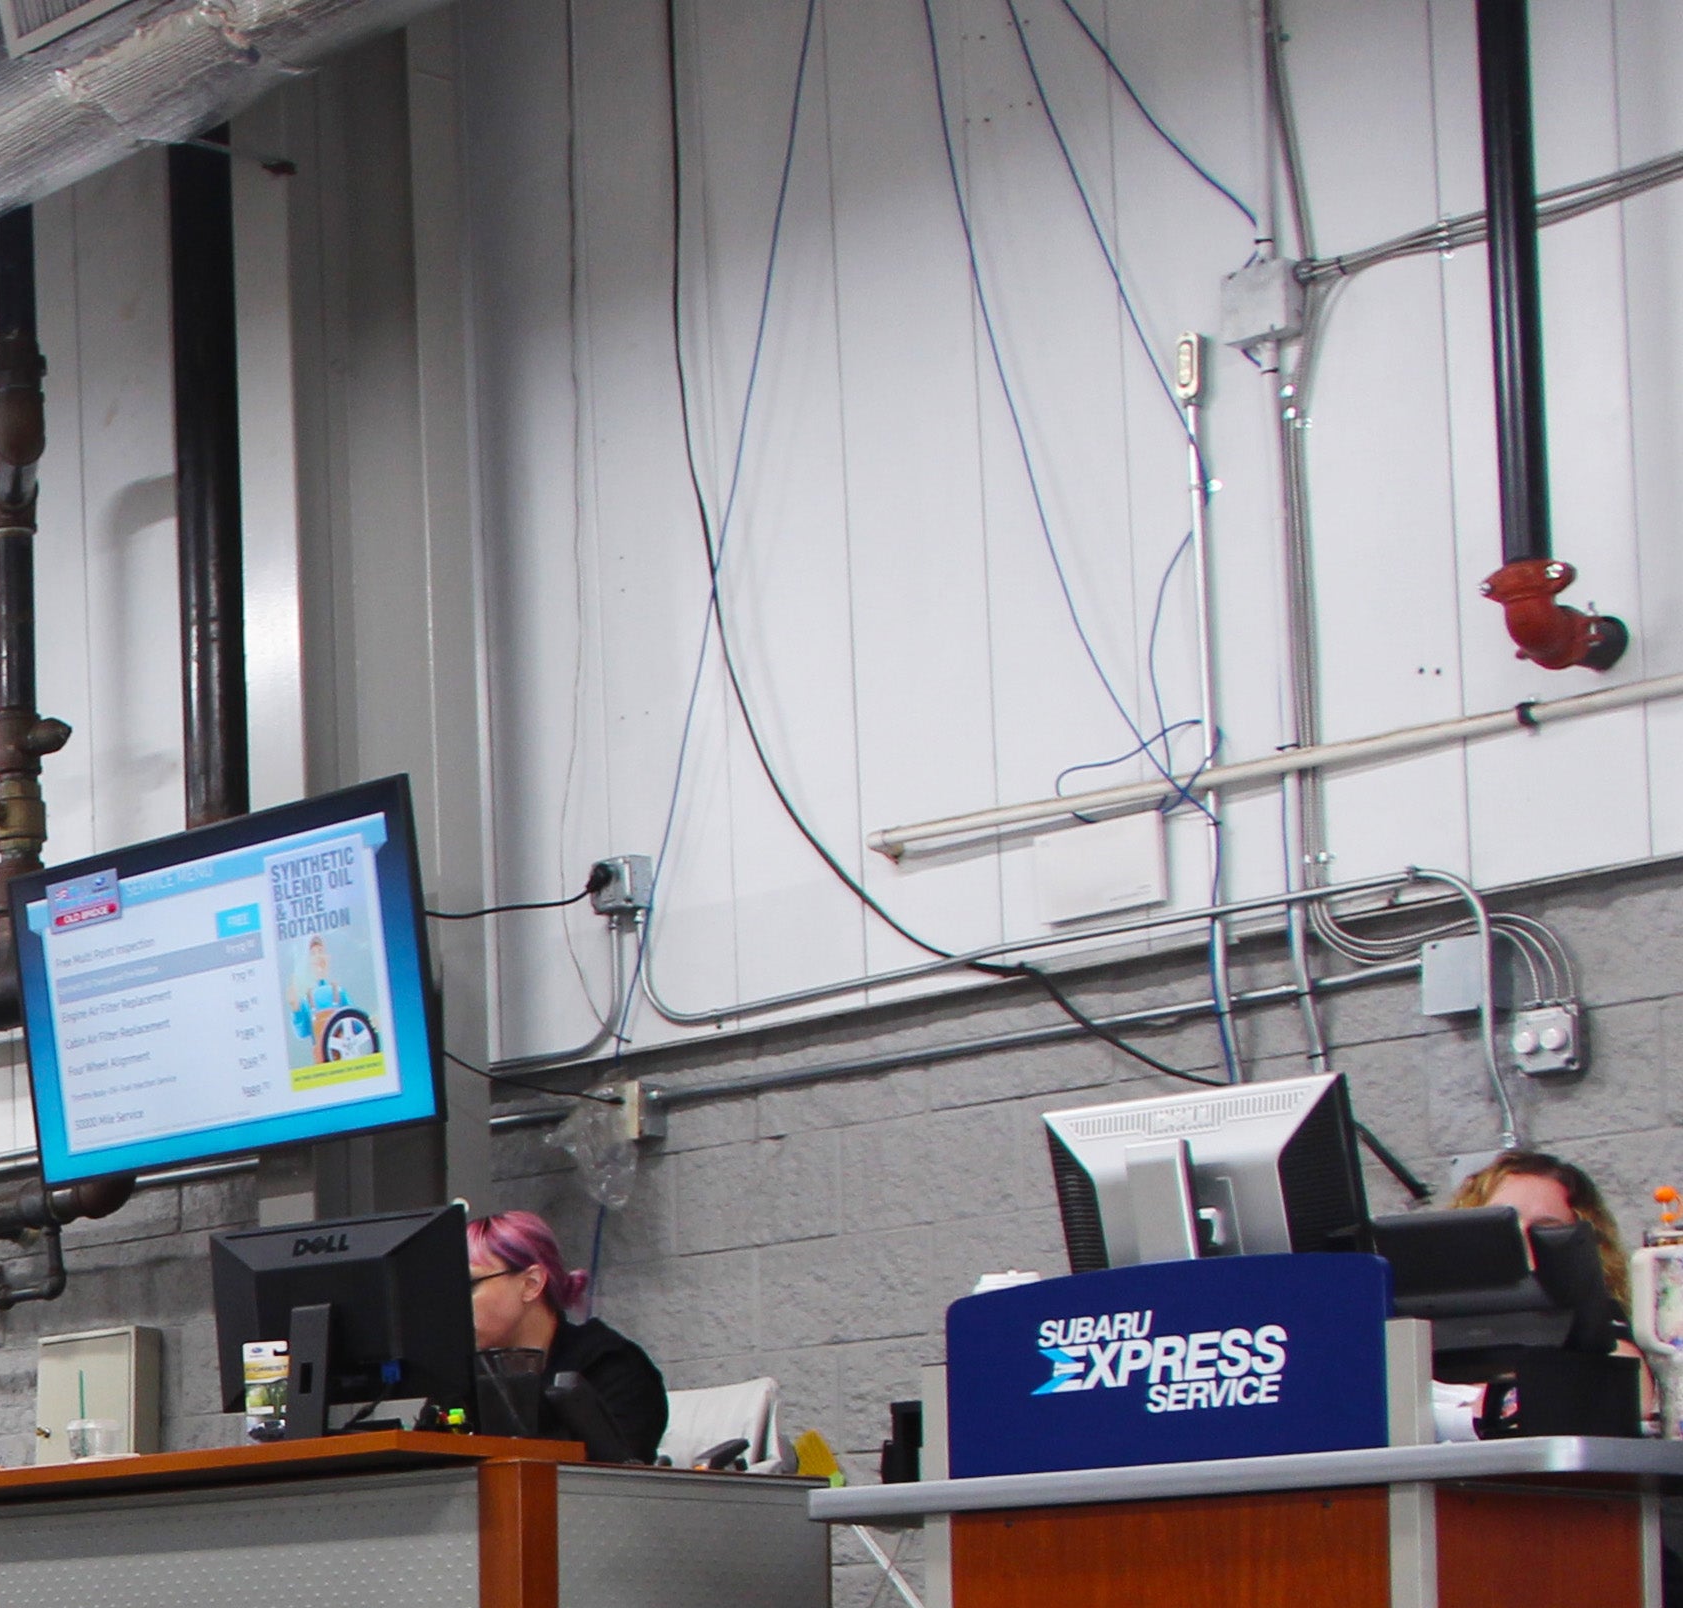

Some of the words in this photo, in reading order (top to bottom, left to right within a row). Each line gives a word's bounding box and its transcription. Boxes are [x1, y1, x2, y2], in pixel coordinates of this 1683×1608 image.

[271, 847, 354, 883] SYNTHETIC
[125, 874, 174, 896] SERVICE
[273, 874, 322, 902] BLEND
[328, 868, 353, 889] OIL
[63, 913, 79, 924] OLD
[81, 906, 108, 920] BRIDGE
[290, 893, 324, 917] TIRE
[278, 907, 350, 941] ROTATION
[122, 991, 172, 1009] Replacement
[120, 1019, 170, 1037] Replacement
[292, 1234, 350, 1257] DELL
[1038, 1310, 1153, 1348] SUBARU
[1031, 1324, 1289, 1395] EXPRESS
[1145, 1374, 1283, 1413] SERVICE
